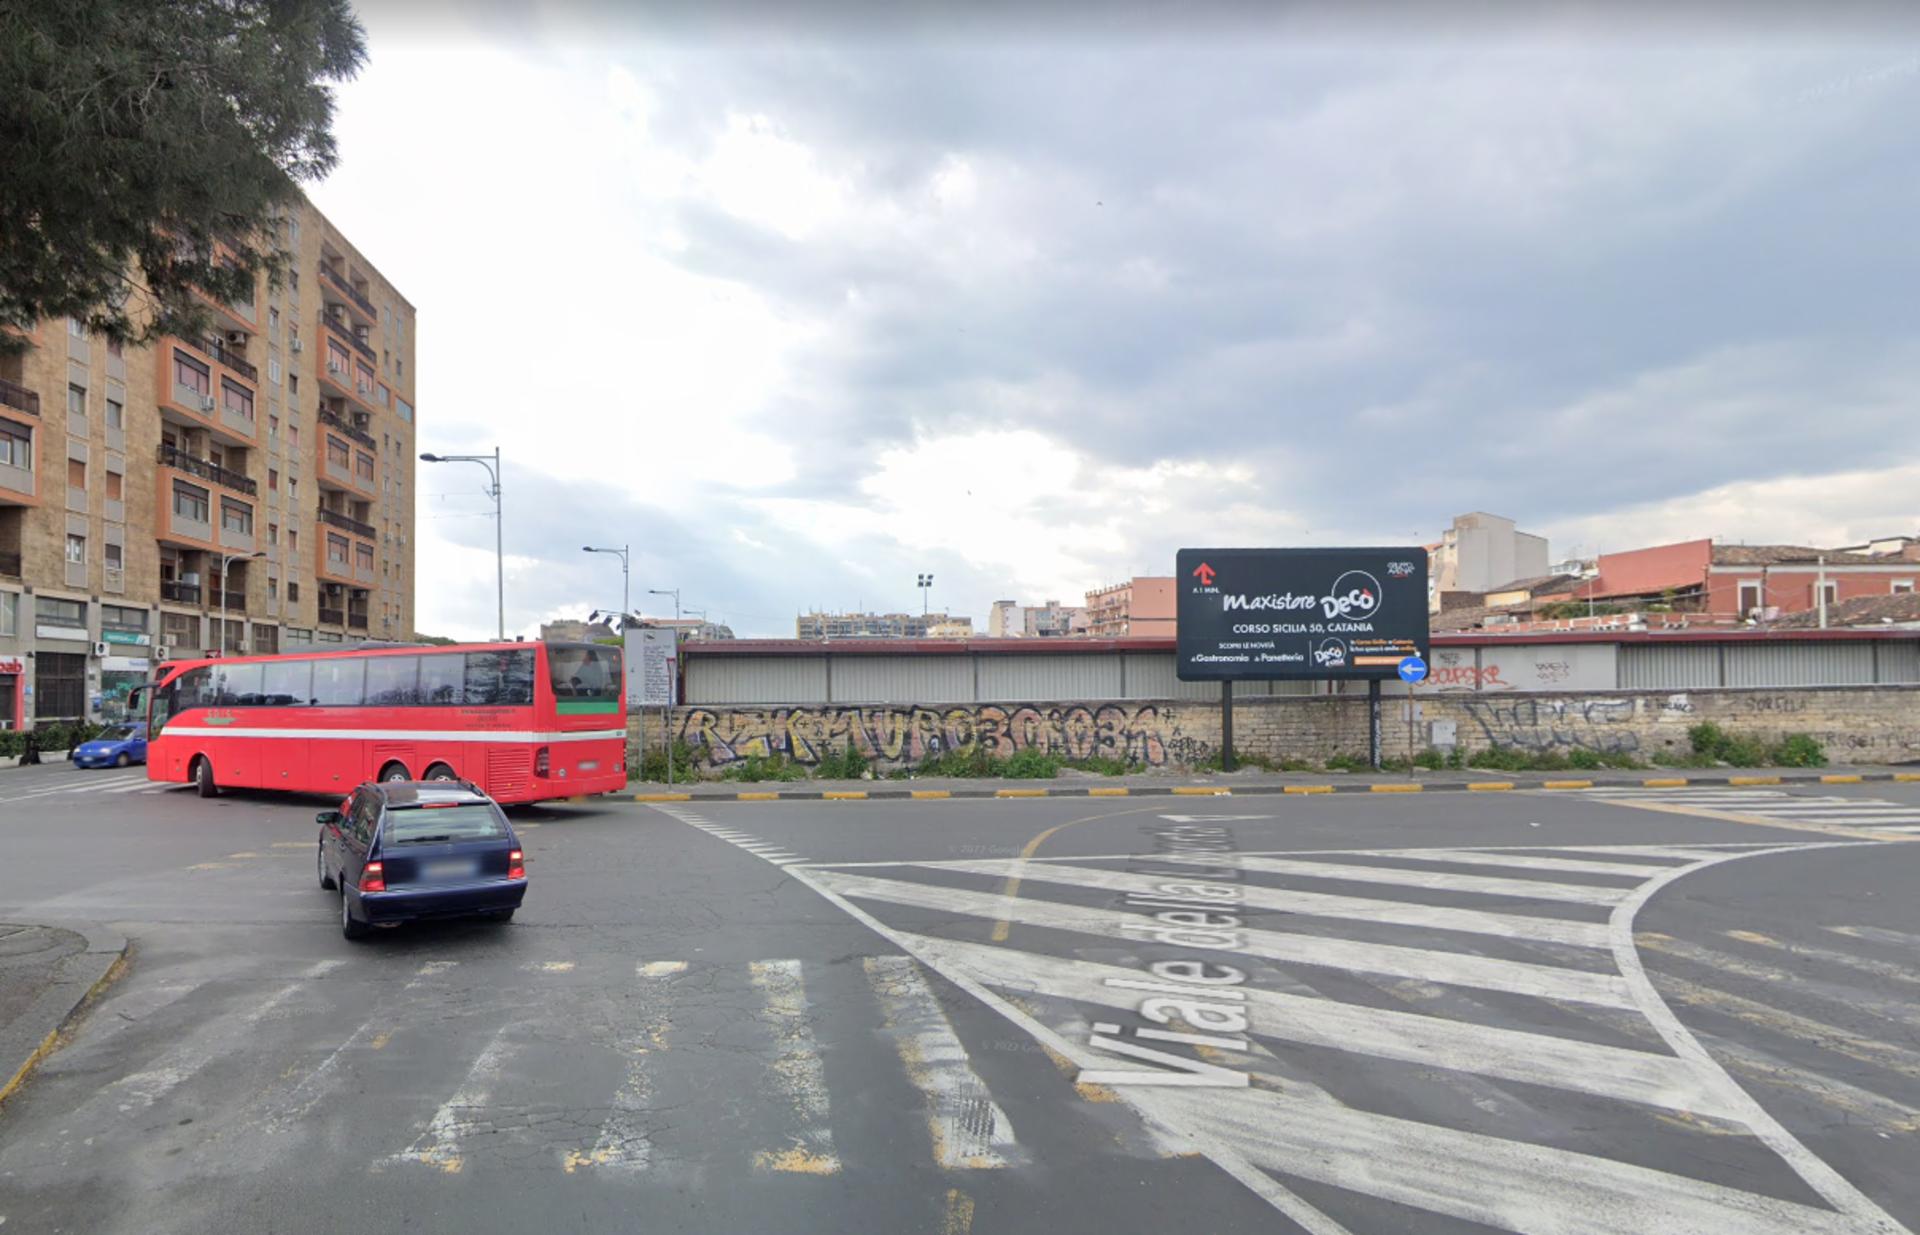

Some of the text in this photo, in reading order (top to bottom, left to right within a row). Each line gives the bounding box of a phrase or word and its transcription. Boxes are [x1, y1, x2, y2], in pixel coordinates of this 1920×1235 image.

[1223, 586, 1374, 619] Maxistore Decò
[1233, 622, 1374, 635] CORSO SICILIA 50, CATANIA
[1196, 653, 1250, 662] Gastronomia
[1261, 652, 1304, 662] Panetteria
